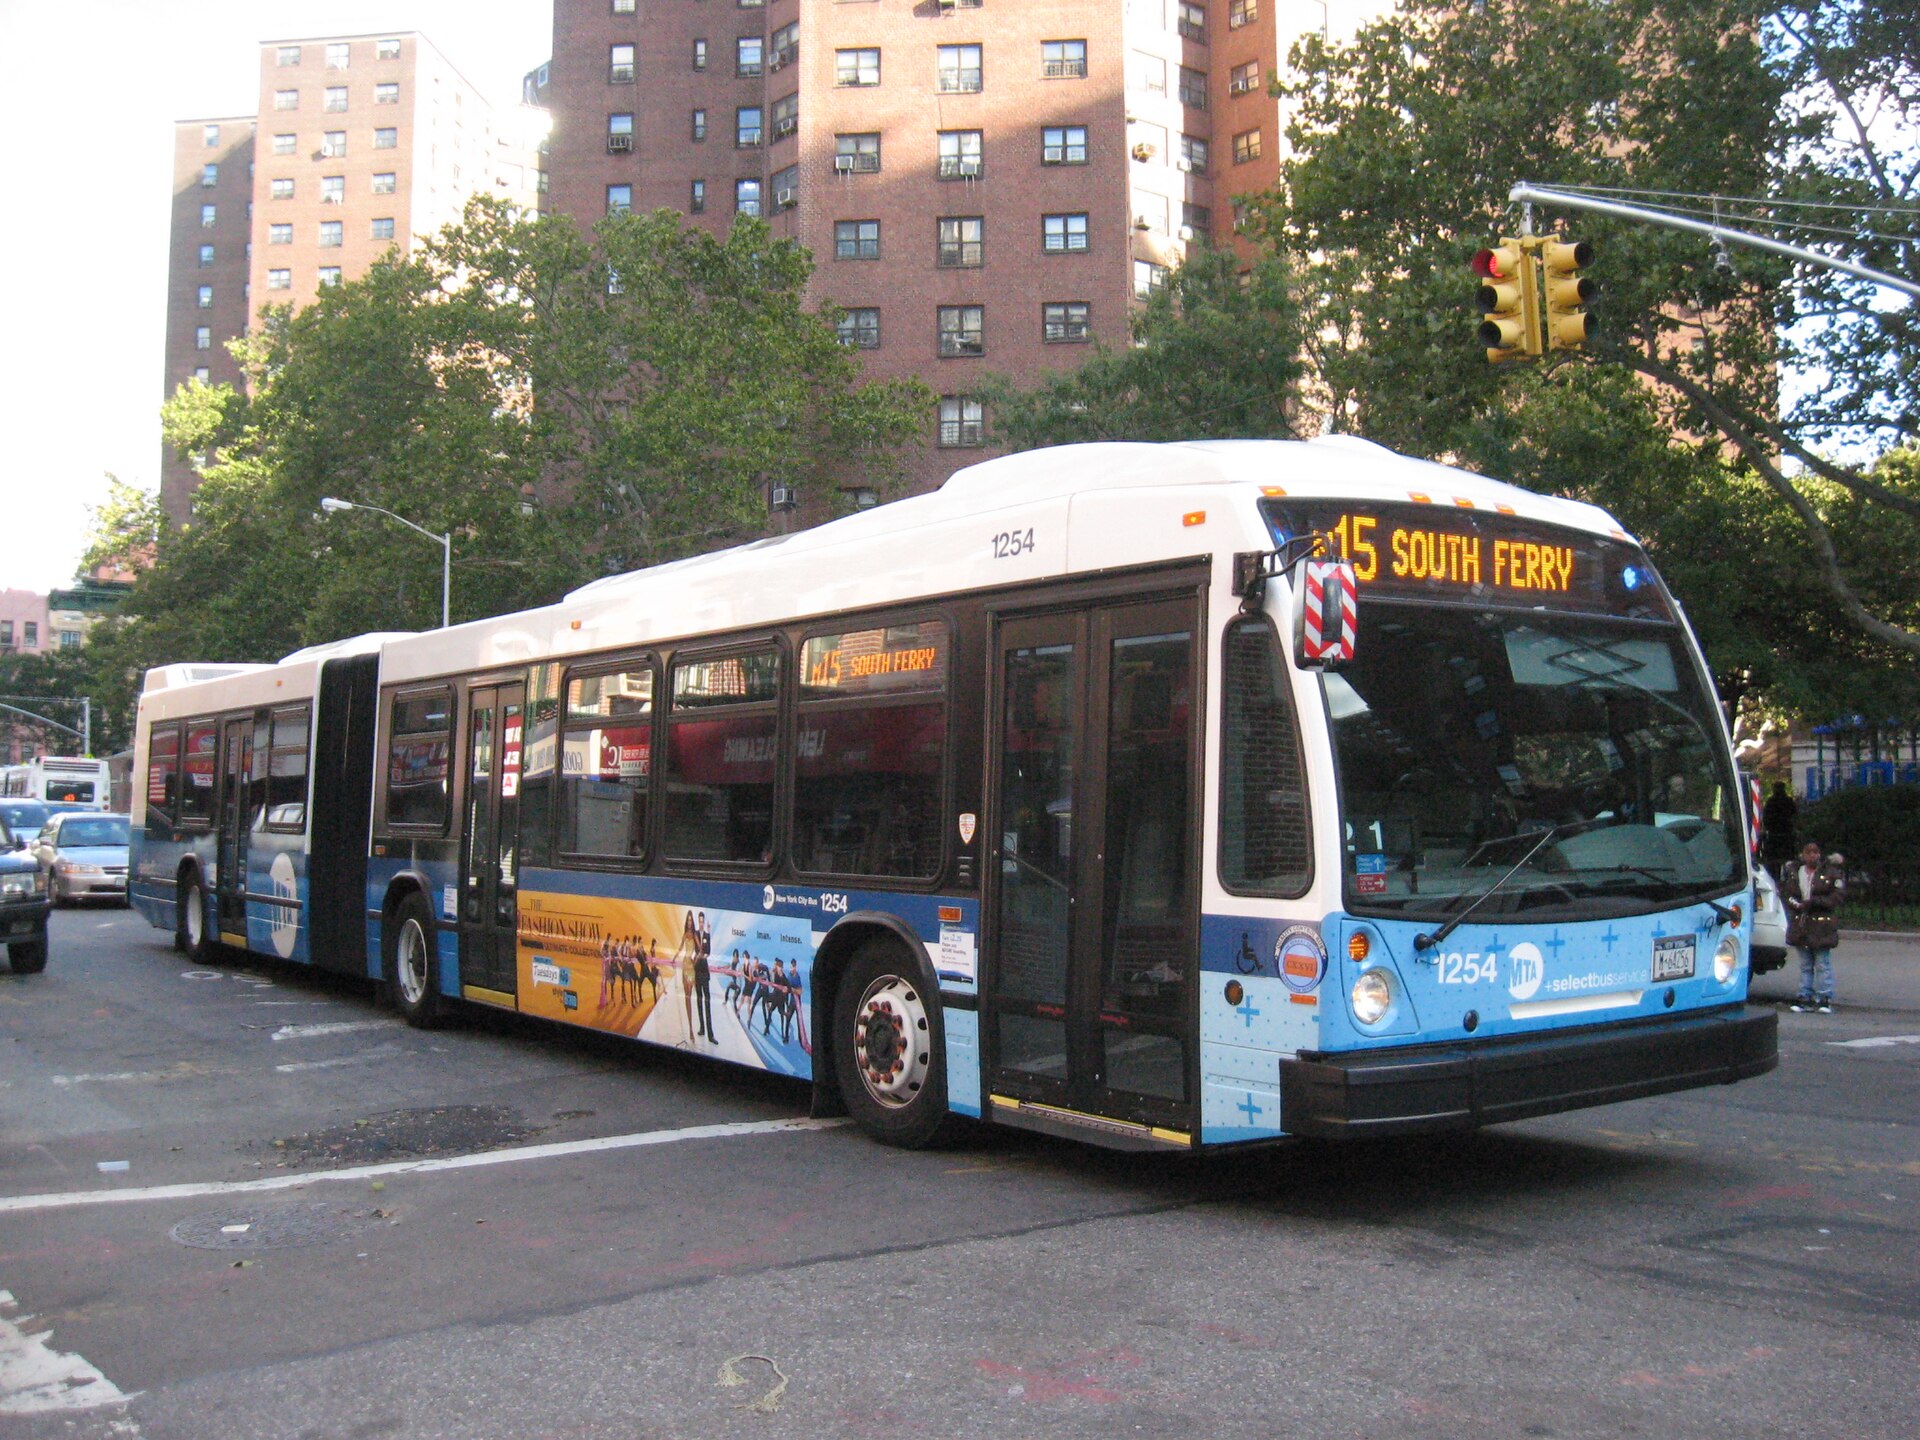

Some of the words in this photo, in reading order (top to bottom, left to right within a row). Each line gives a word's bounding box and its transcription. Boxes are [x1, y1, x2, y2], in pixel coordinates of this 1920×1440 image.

[991, 527, 1035, 559] 1254
[1392, 528, 1480, 583] SOUTH
[1493, 539, 1573, 591] FERRY
[811, 651, 842, 686] M15
[850, 653, 891, 677] SOUTH
[894, 648, 936, 672] FERRY
[775, 894, 787, 903] New
[787, 895, 798, 904] York
[798, 896, 808, 906] City
[808, 897, 818, 906] Bus
[820, 893, 848, 913] 1254
[521, 914, 566, 936] FASHION
[568, 920, 601, 940] SHOW
[533, 964, 559, 981] Tuesdays
[1433, 952, 1498, 984] 1254
